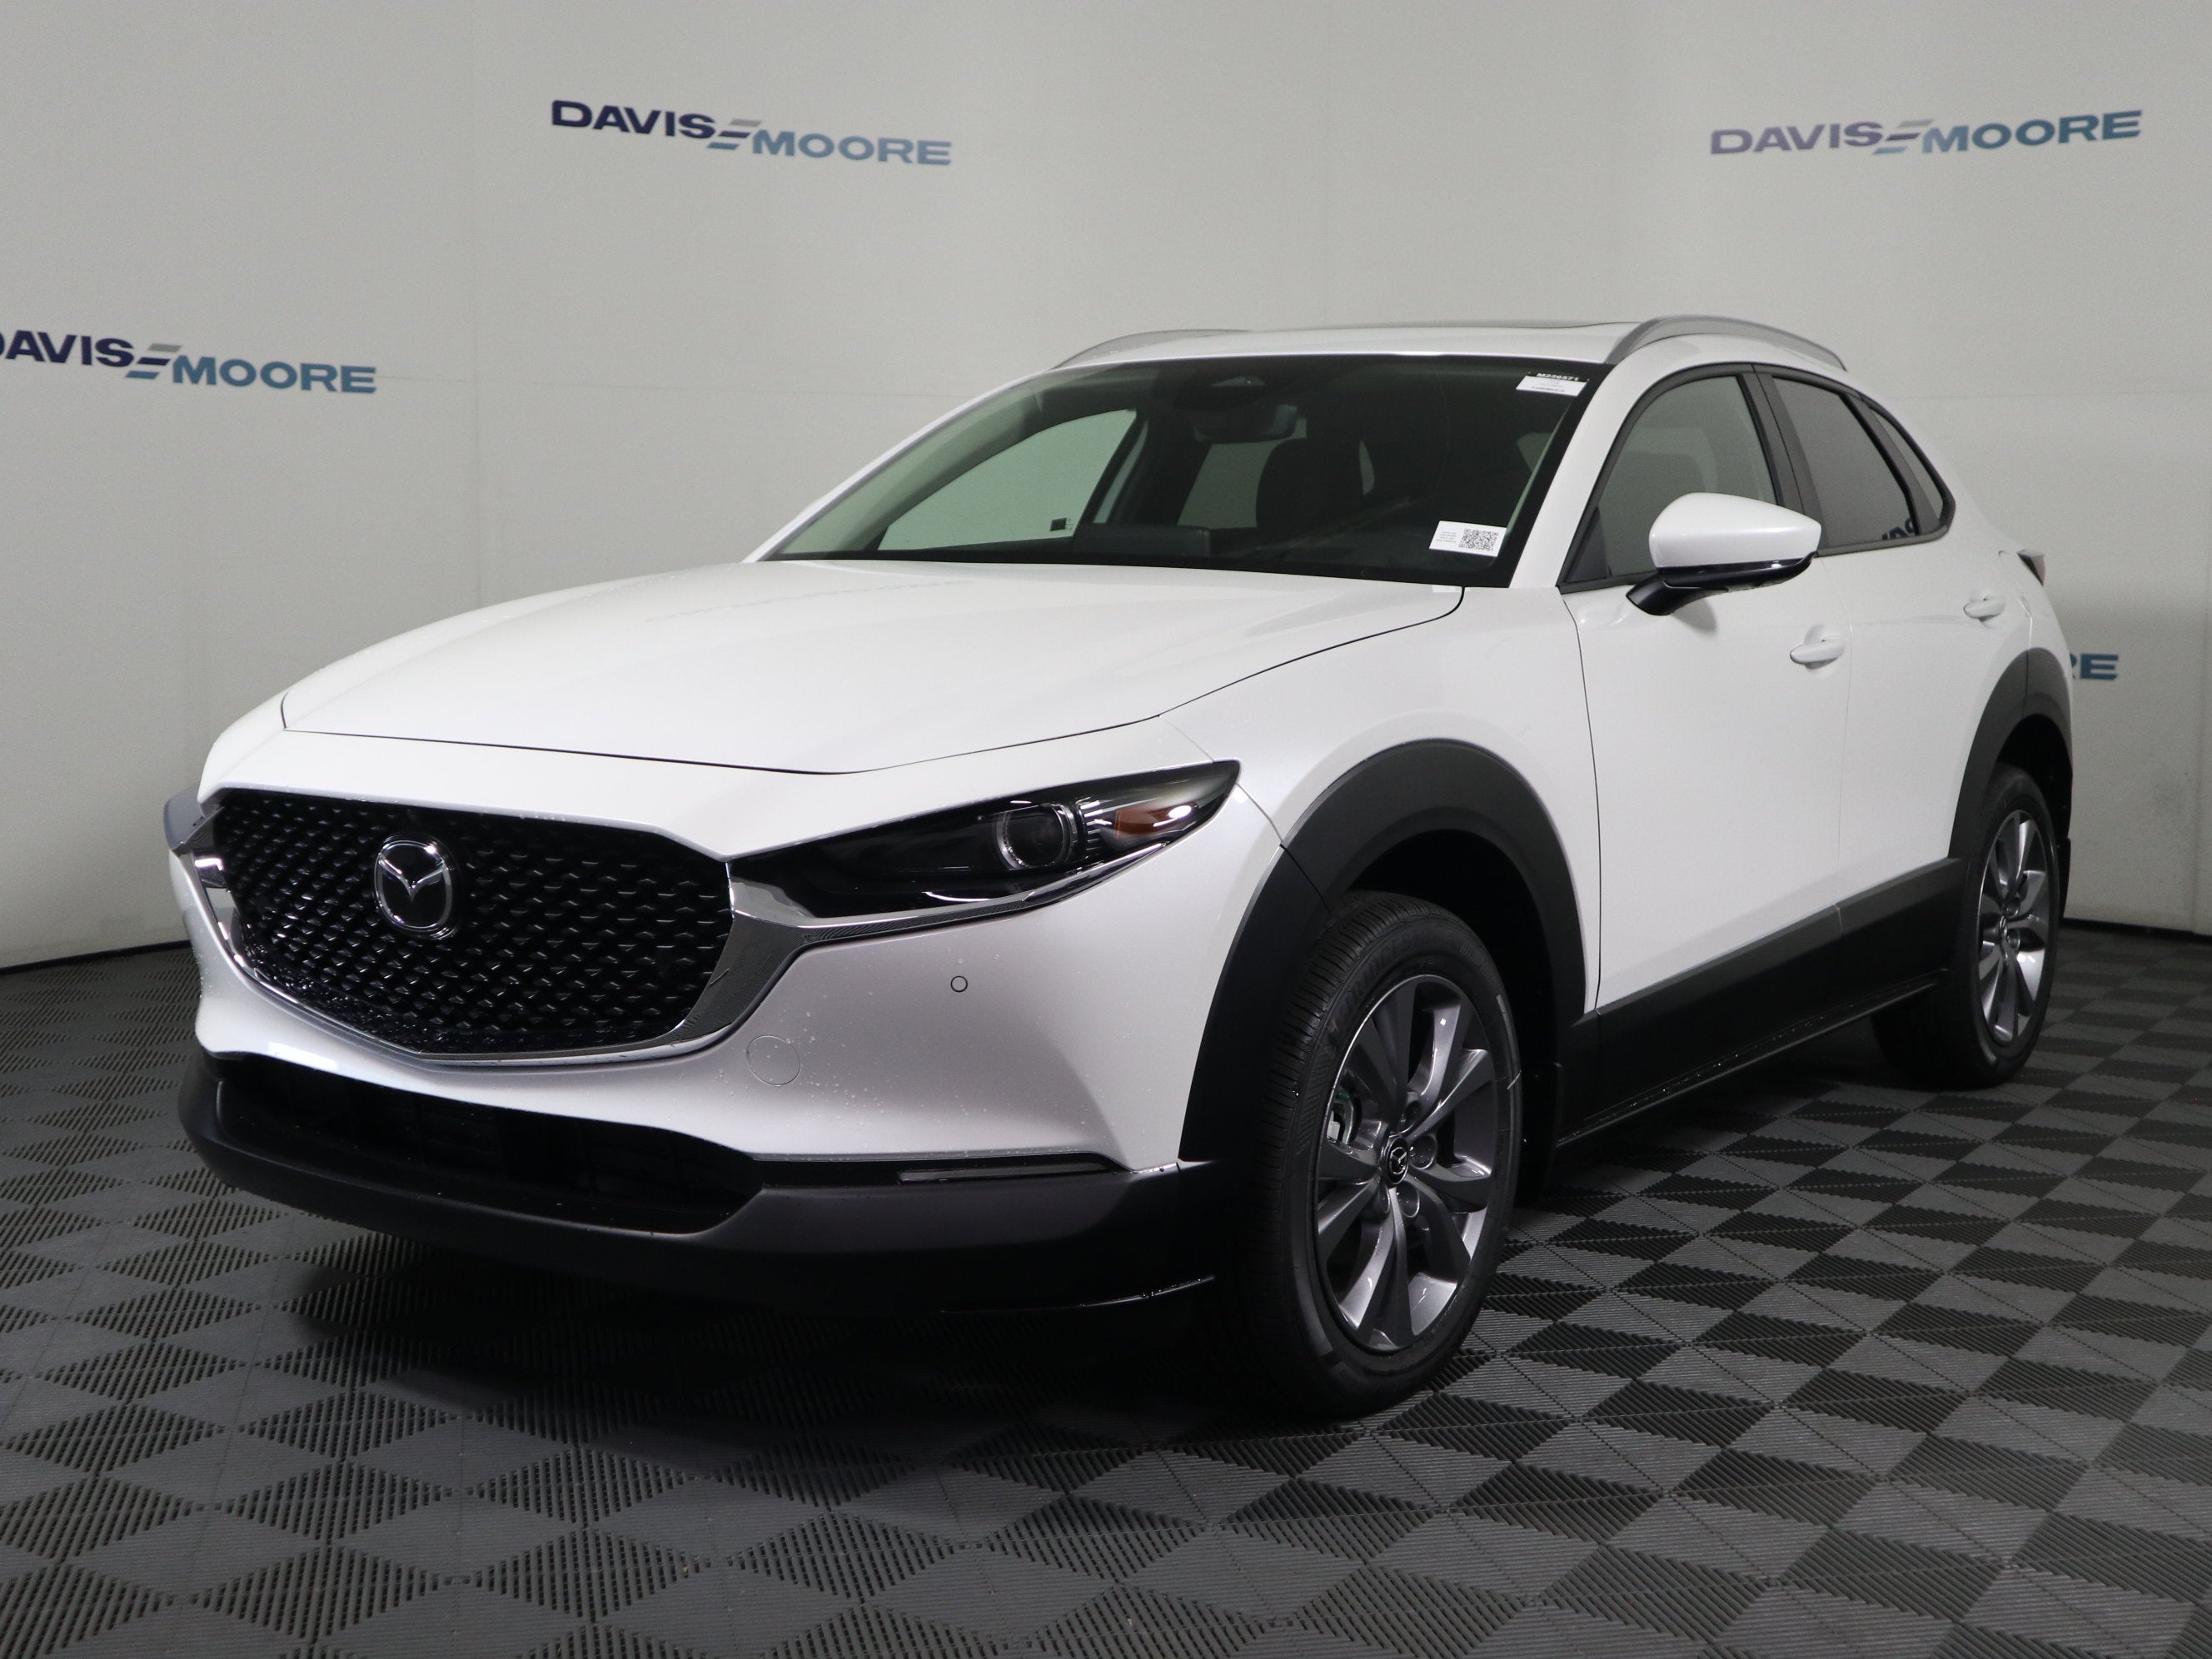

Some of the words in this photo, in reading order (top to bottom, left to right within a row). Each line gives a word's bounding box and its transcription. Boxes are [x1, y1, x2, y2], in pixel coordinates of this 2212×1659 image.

[551, 98, 717, 141] DAVIS
[752, 129, 952, 166] MOORE
[1711, 121, 1884, 155] DAVIS
[1923, 109, 2143, 154] MOORE
[0, 329, 135, 368] AVIS
[172, 354, 377, 395] MOORE
